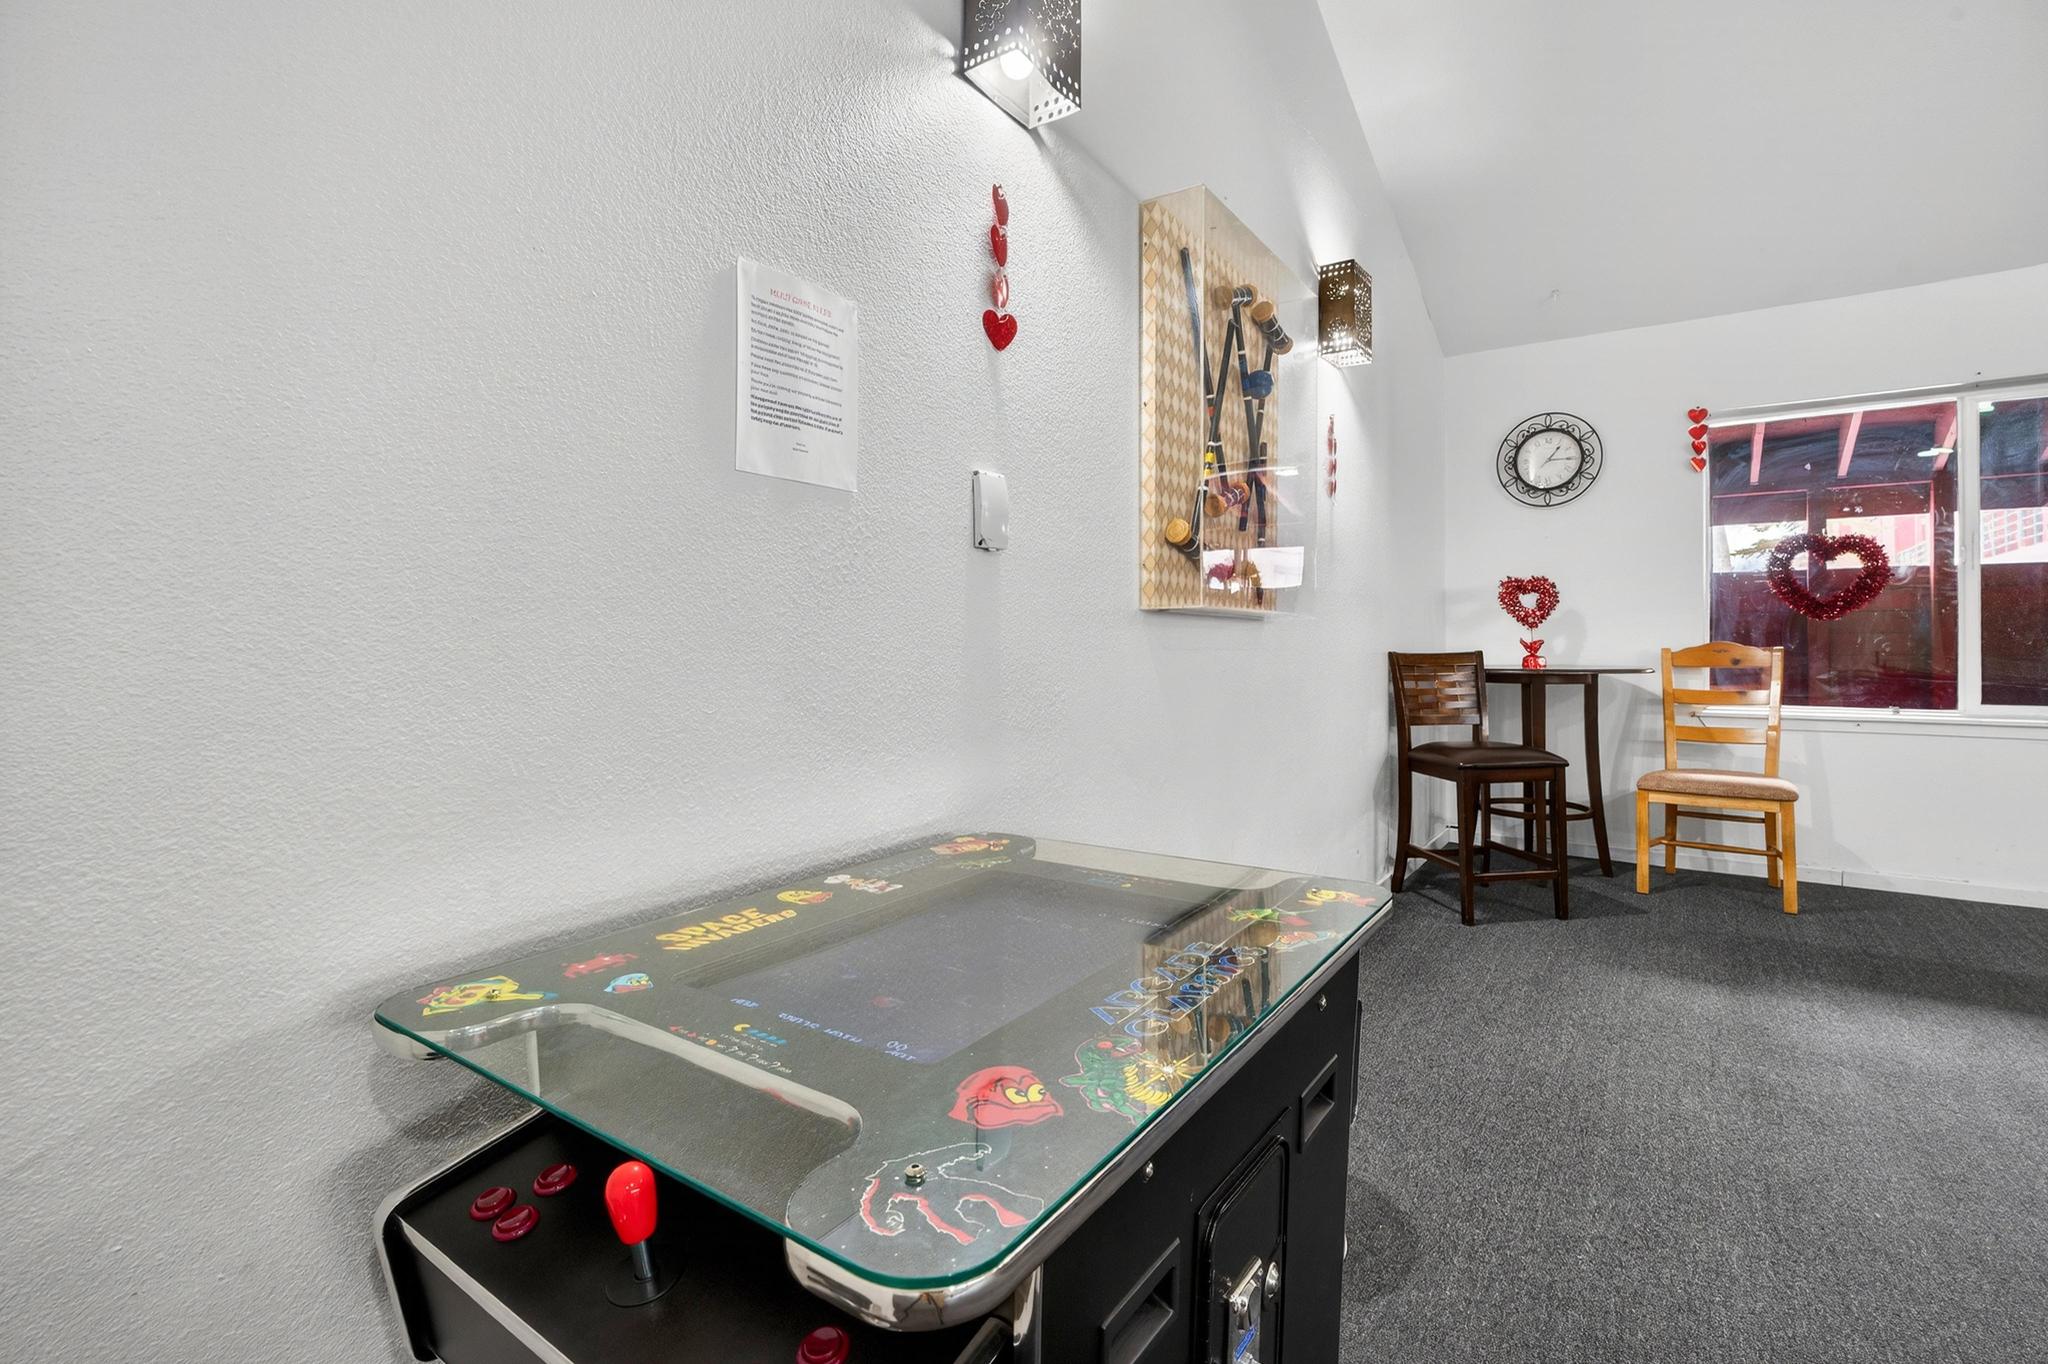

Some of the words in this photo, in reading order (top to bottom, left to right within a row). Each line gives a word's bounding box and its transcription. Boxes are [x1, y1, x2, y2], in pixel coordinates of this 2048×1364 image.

[655, 907, 767, 941] SPACE
[662, 908, 798, 951] INVADERS
[1089, 941, 1219, 1026] ARCADE
